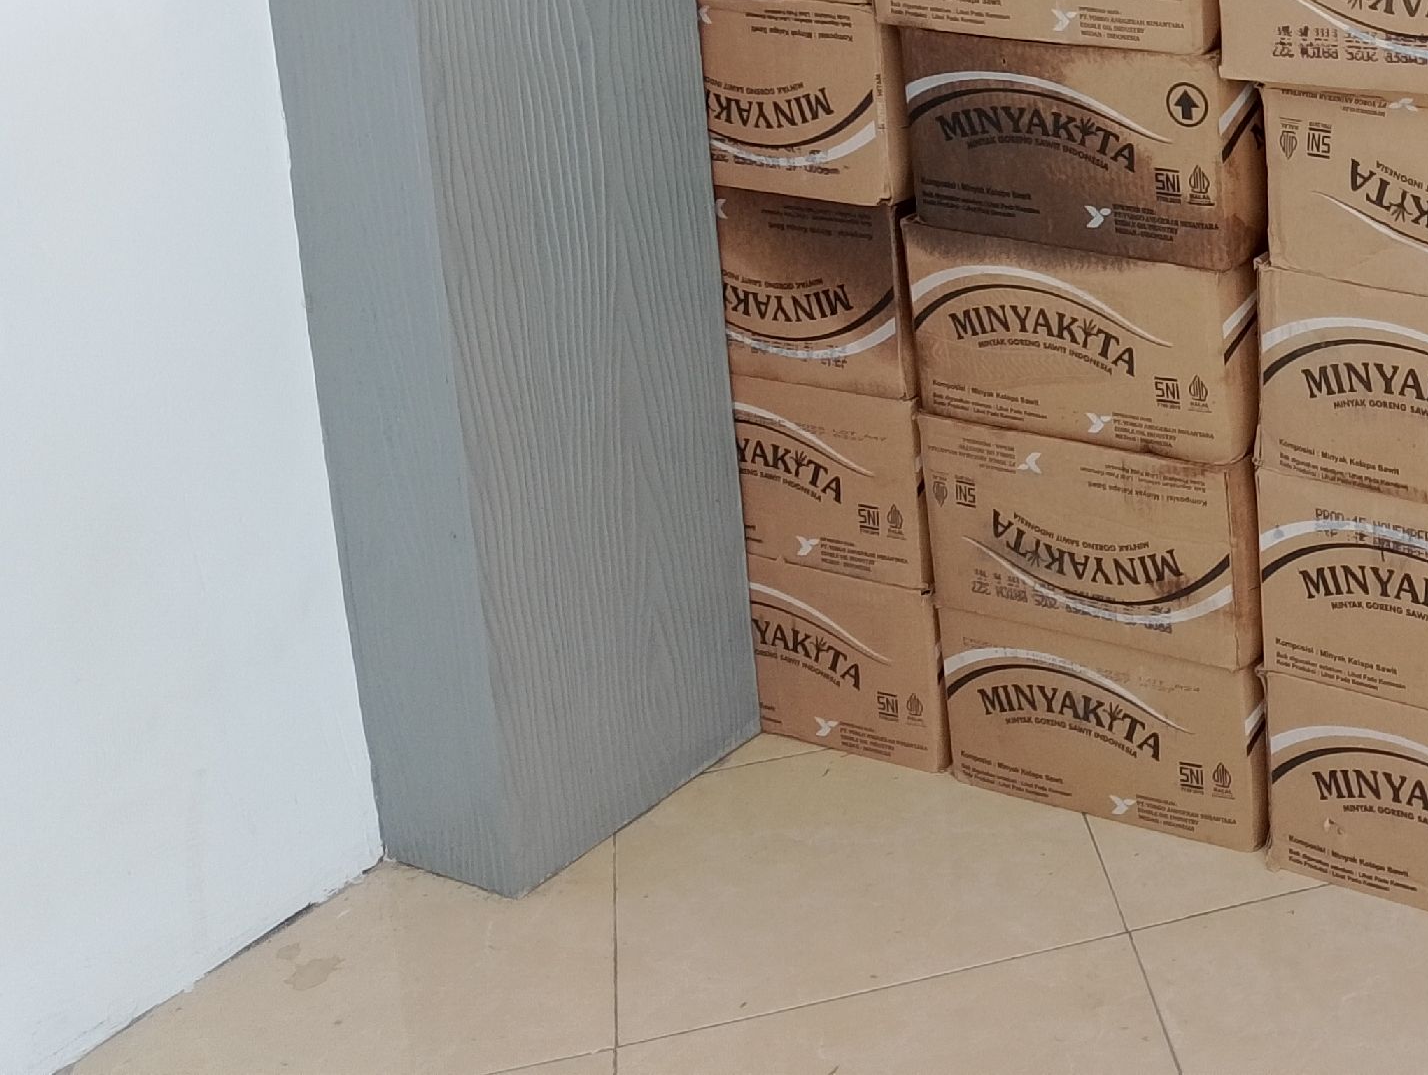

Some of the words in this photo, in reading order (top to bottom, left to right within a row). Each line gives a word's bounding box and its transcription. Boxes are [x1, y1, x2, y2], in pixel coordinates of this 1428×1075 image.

[1307, 132, 1333, 153] SNI
[1155, 172, 1180, 193] SNI
[1377, 160, 1424, 190] INDONESIA
[1154, 380, 1179, 399] SNI
[1333, 398, 1365, 408] MINYAK
[1368, 398, 1406, 411] GORENG
[955, 483, 976, 503] SNI
[857, 507, 879, 526] SNI
[1330, 599, 1363, 609] MINYAK
[1365, 600, 1402, 613] GORENG
[876, 694, 898, 713] SNI
[1178, 765, 1203, 785] SNI
[1342, 803, 1374, 812] MINYAK
[1377, 804, 1414, 819] GORENG
